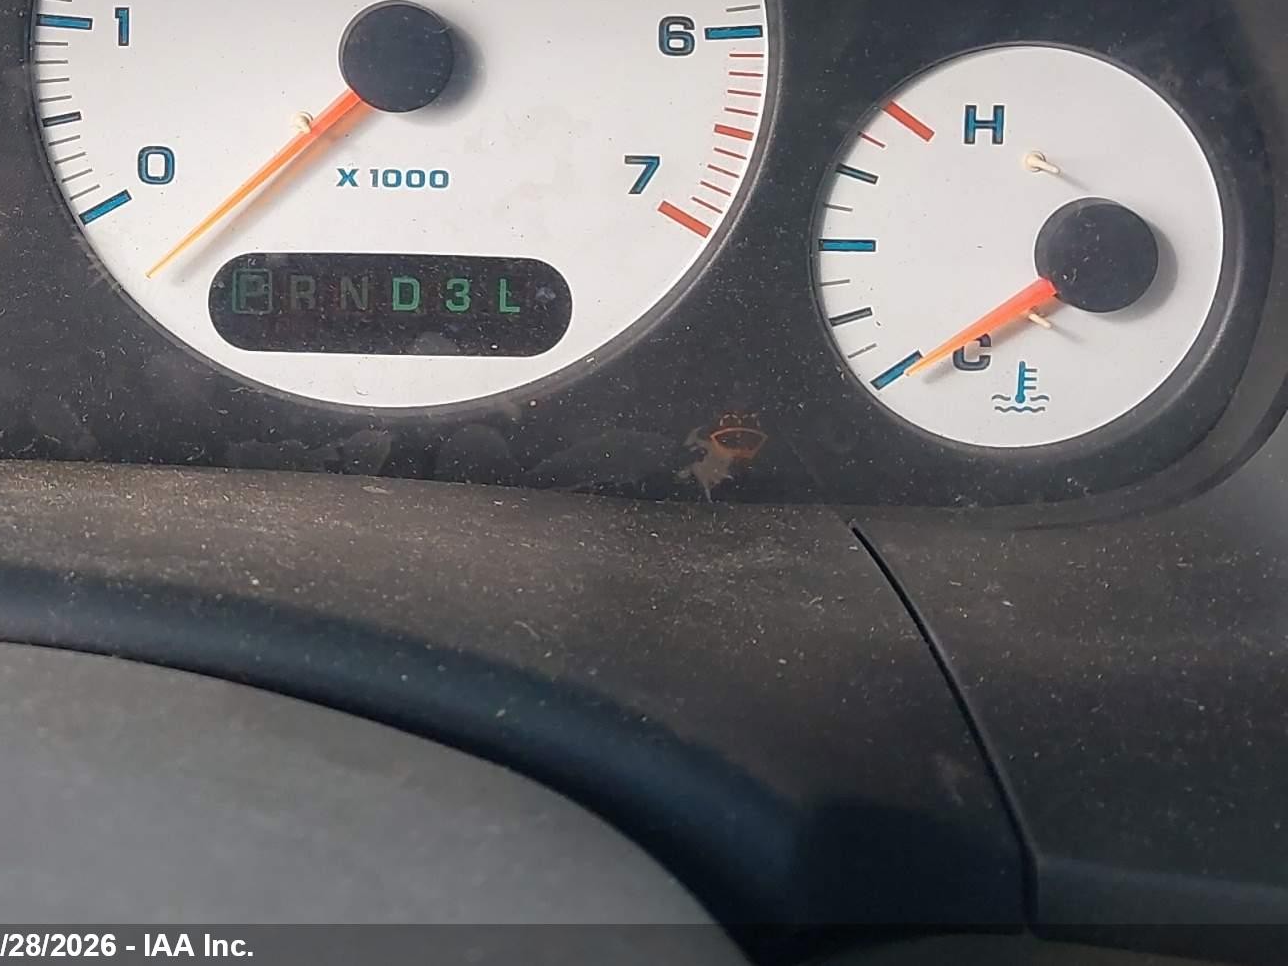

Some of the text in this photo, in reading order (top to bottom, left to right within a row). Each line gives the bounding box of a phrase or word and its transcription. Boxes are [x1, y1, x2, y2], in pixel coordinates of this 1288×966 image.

[114, 7, 130, 46] 1
[657, 15, 695, 56] 6
[964, 105, 1005, 145] H
[137, 145, 175, 185] 0
[336, 168, 450, 189] X 1000
[623, 155, 661, 195] 7
[392, 276, 421, 312] D
[446, 277, 471, 312] 3
[499, 278, 521, 313] L
[953, 333, 993, 371] C
